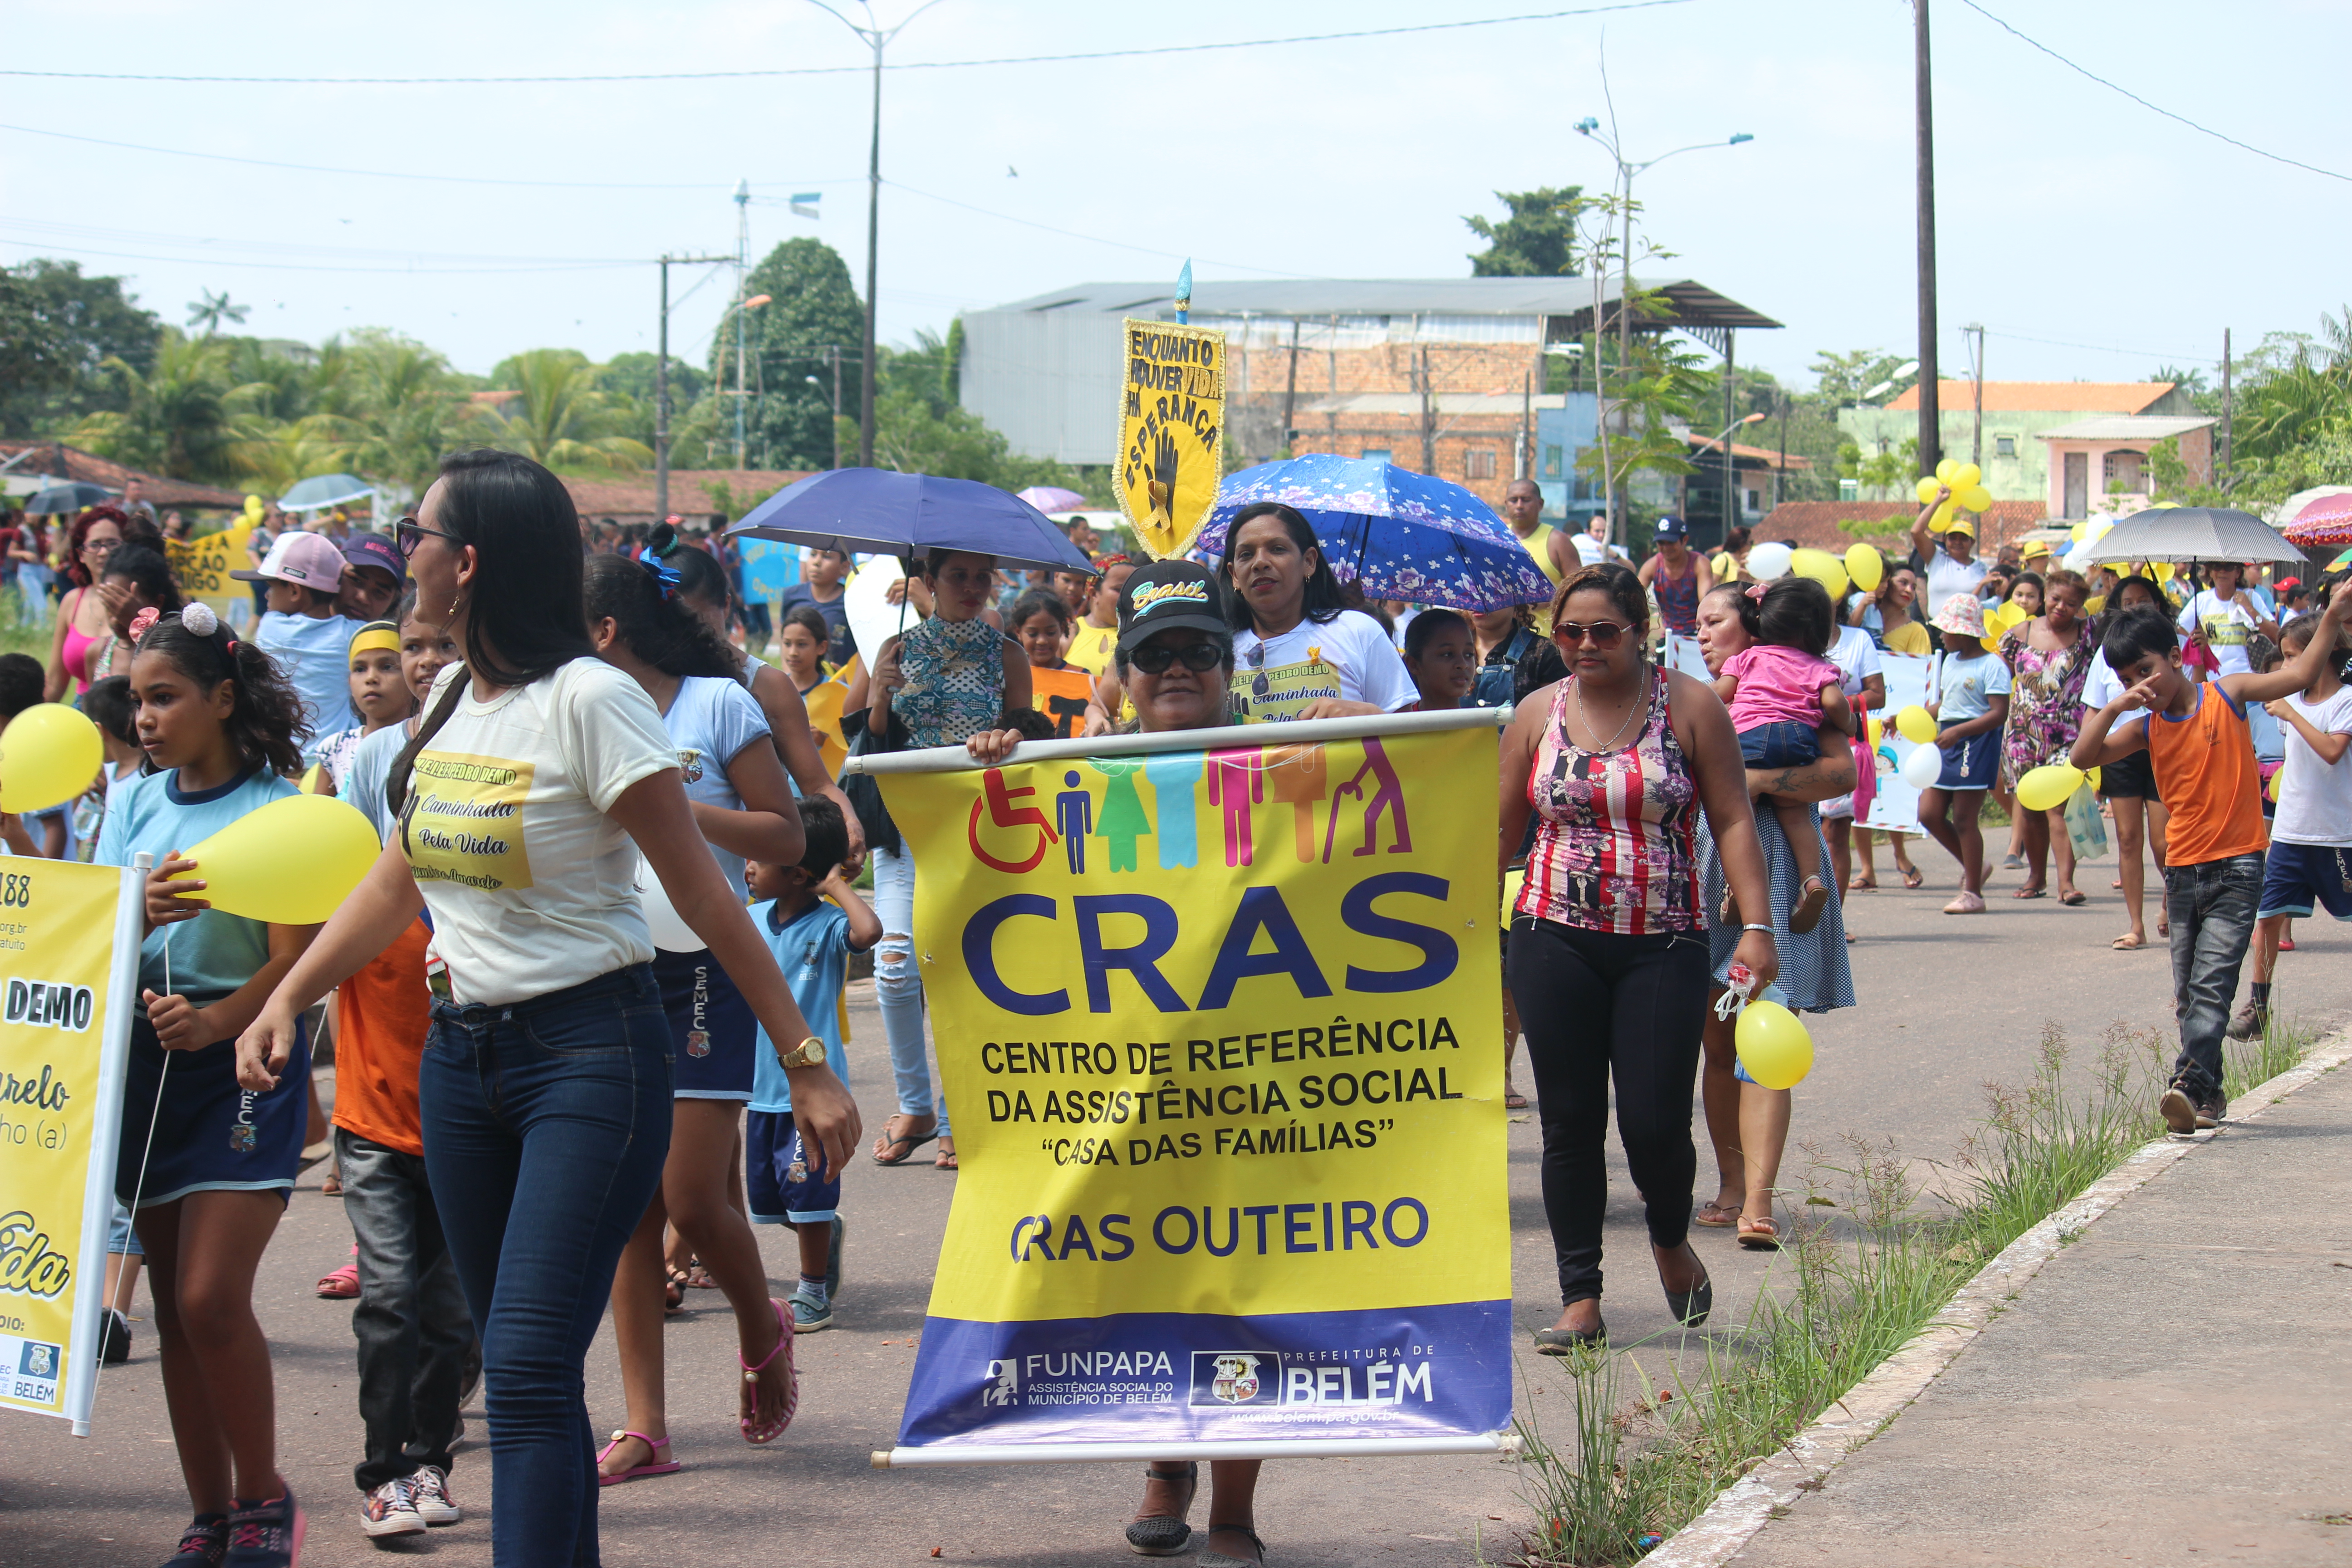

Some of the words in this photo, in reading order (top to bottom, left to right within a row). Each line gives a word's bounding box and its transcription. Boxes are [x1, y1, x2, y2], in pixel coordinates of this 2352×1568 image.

[1132, 331, 1213, 367] ENQUANTO
[1130, 358, 1183, 392] HOUVER
[1183, 366, 1220, 400] VIDA
[1125, 394, 1218, 491] ESPERANÇA
[1131, 580, 1209, 610] Brasil
[1269, 667, 1299, 681] PEDRO
[1301, 663, 1330, 677] DEMO
[452, 763, 481, 782] PEDRO
[479, 767, 516, 785] DEMO
[421, 794, 517, 819] Caminhada
[419, 829, 453, 850] Pela
[455, 832, 510, 856] Vida
[411, 865, 449, 880] etembro
[449, 868, 504, 890] Amarelo
[961, 871, 1459, 1016] CRAS
[6, 980, 92, 1029] DEMO
[692, 966, 708, 1030] SEMEC
[981, 1042, 1117, 1075] CENTRO
[1127, 1043, 1172, 1075] DE
[1188, 1015, 1460, 1072] REFERÊNCIA
[987, 1090, 1036, 1122] DA
[1043, 1079, 1290, 1125] ASSISTÊNCIA
[1299, 1067, 1463, 1109] SOCIAL
[36, 1119, 67, 1150] (a)
[1129, 1132, 1202, 1166] DAS
[1010, 1214, 1134, 1264] CRAS
[1152, 1197, 1429, 1257] OUTEIRO
[1027, 1351, 1174, 1377] FUNPAPA
[1284, 1347, 1401, 1361] PREFEITURA
[1413, 1345, 1434, 1356] DE
[14, 1381, 54, 1403] BELÉM
[1028, 1382, 1107, 1393] ASSISTÊNCIA
[1109, 1382, 1154, 1392] SOCIAL
[1155, 1382, 1173, 1392] DO
[1028, 1391, 1100, 1405] MUNICÍPIO
[1103, 1393, 1122, 1404] DE
[1126, 1391, 1172, 1404] BELÉM
[1286, 1359, 1434, 1407] BELÉM
